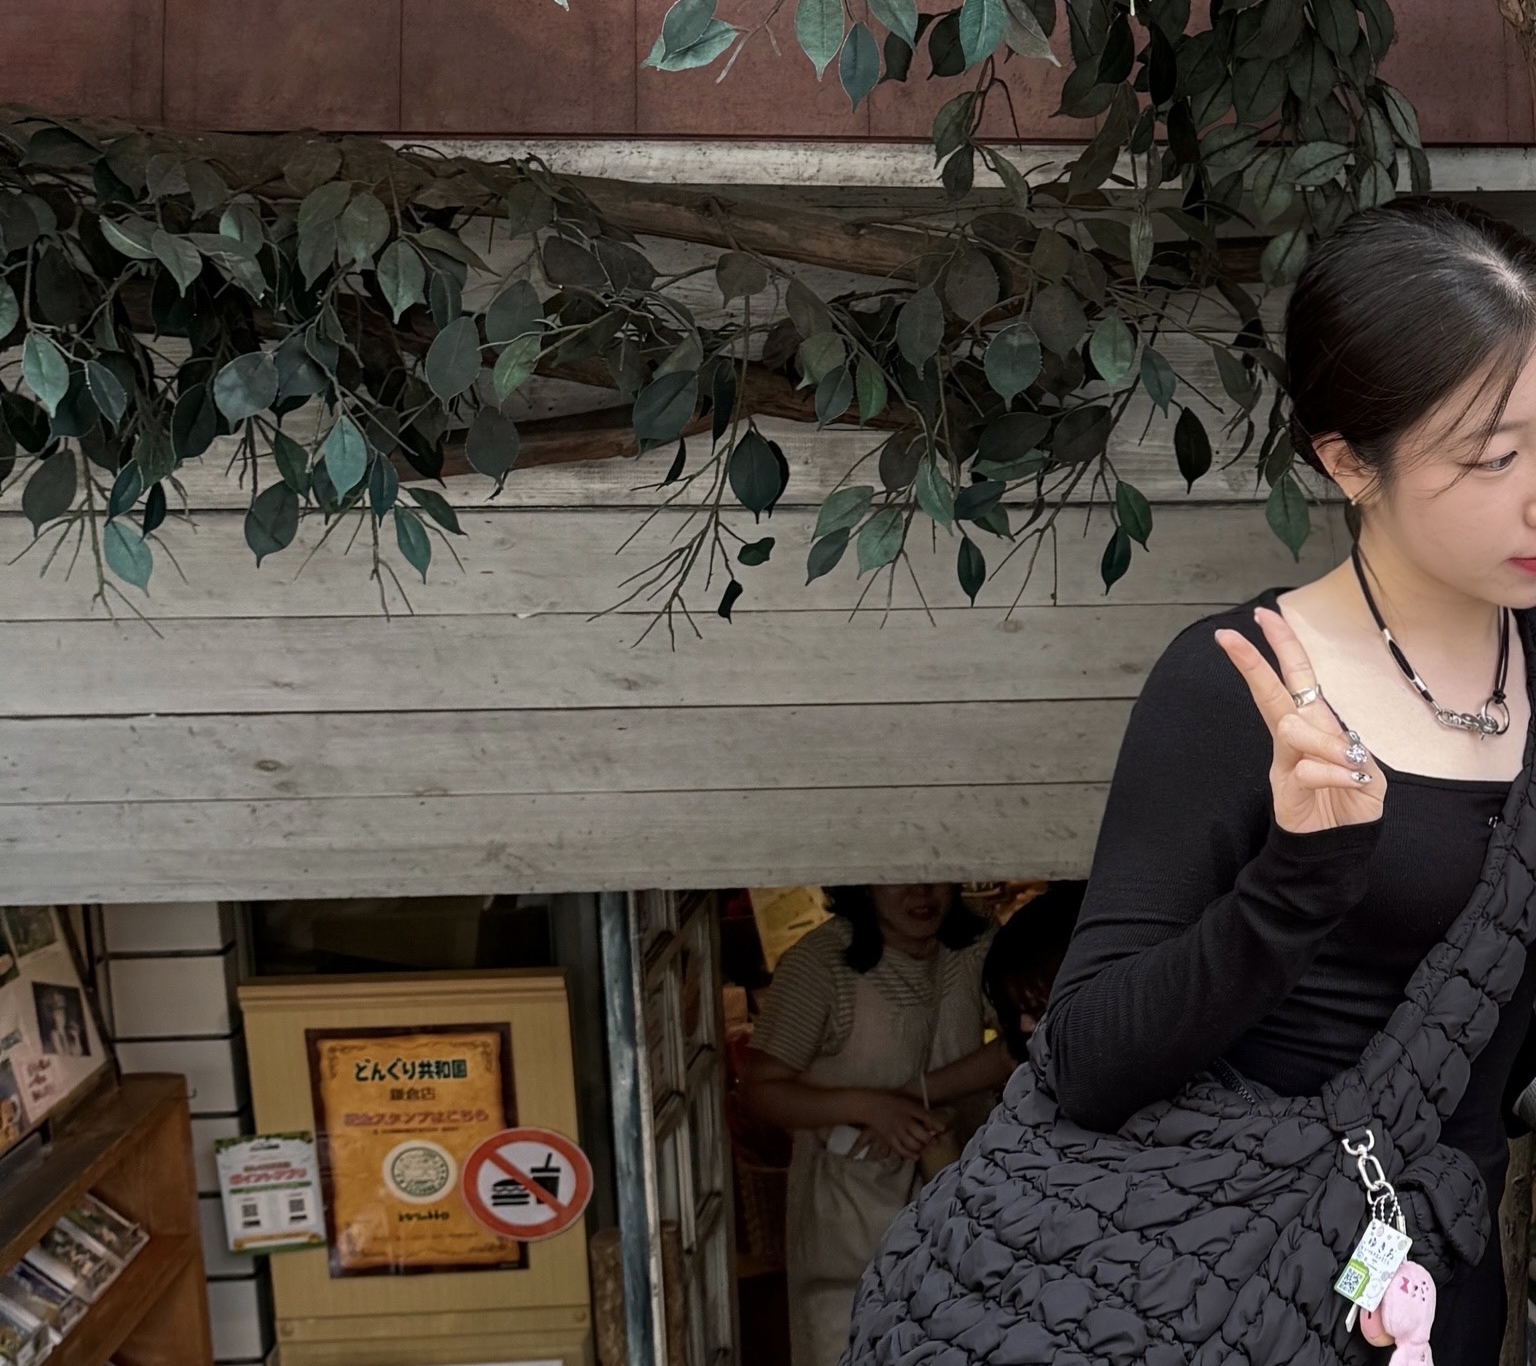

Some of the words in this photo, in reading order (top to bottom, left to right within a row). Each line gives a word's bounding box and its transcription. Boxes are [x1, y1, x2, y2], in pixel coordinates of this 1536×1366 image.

[354, 1057, 468, 1083] どんぐり共和国
